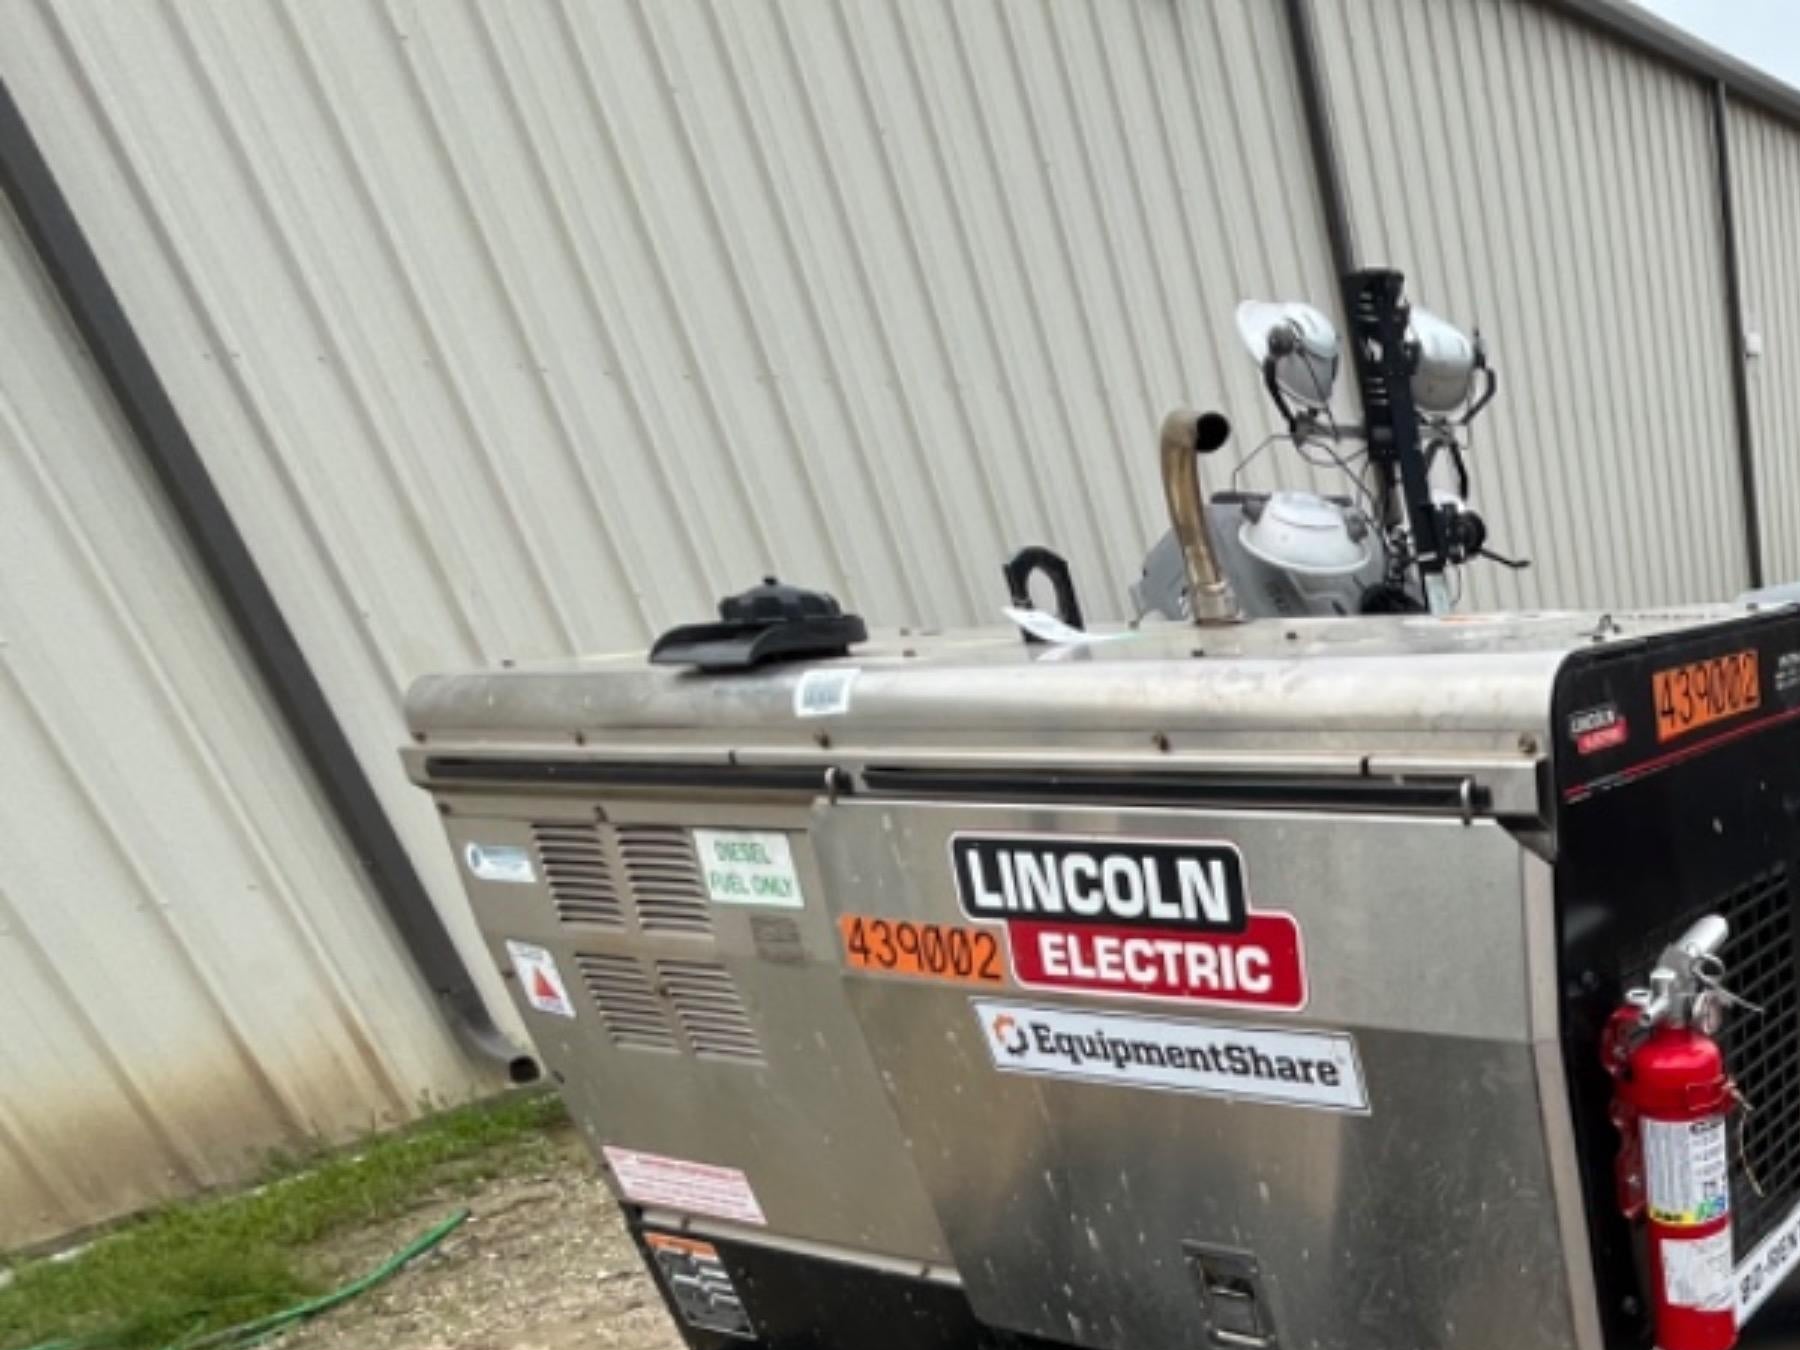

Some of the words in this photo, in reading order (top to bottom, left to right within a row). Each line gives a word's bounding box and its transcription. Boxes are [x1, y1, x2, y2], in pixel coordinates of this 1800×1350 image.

[1661, 652, 1757, 728] 439002
[710, 869, 751, 895] FUEL
[750, 872, 793, 898] ONLY
[713, 839, 771, 865] DIESEL
[966, 847, 1231, 923] LINCOLN
[848, 916, 1002, 981] 439002
[1038, 933, 1273, 993] ELECTRIC
[1029, 1022, 1340, 1087] EquipmentShare
